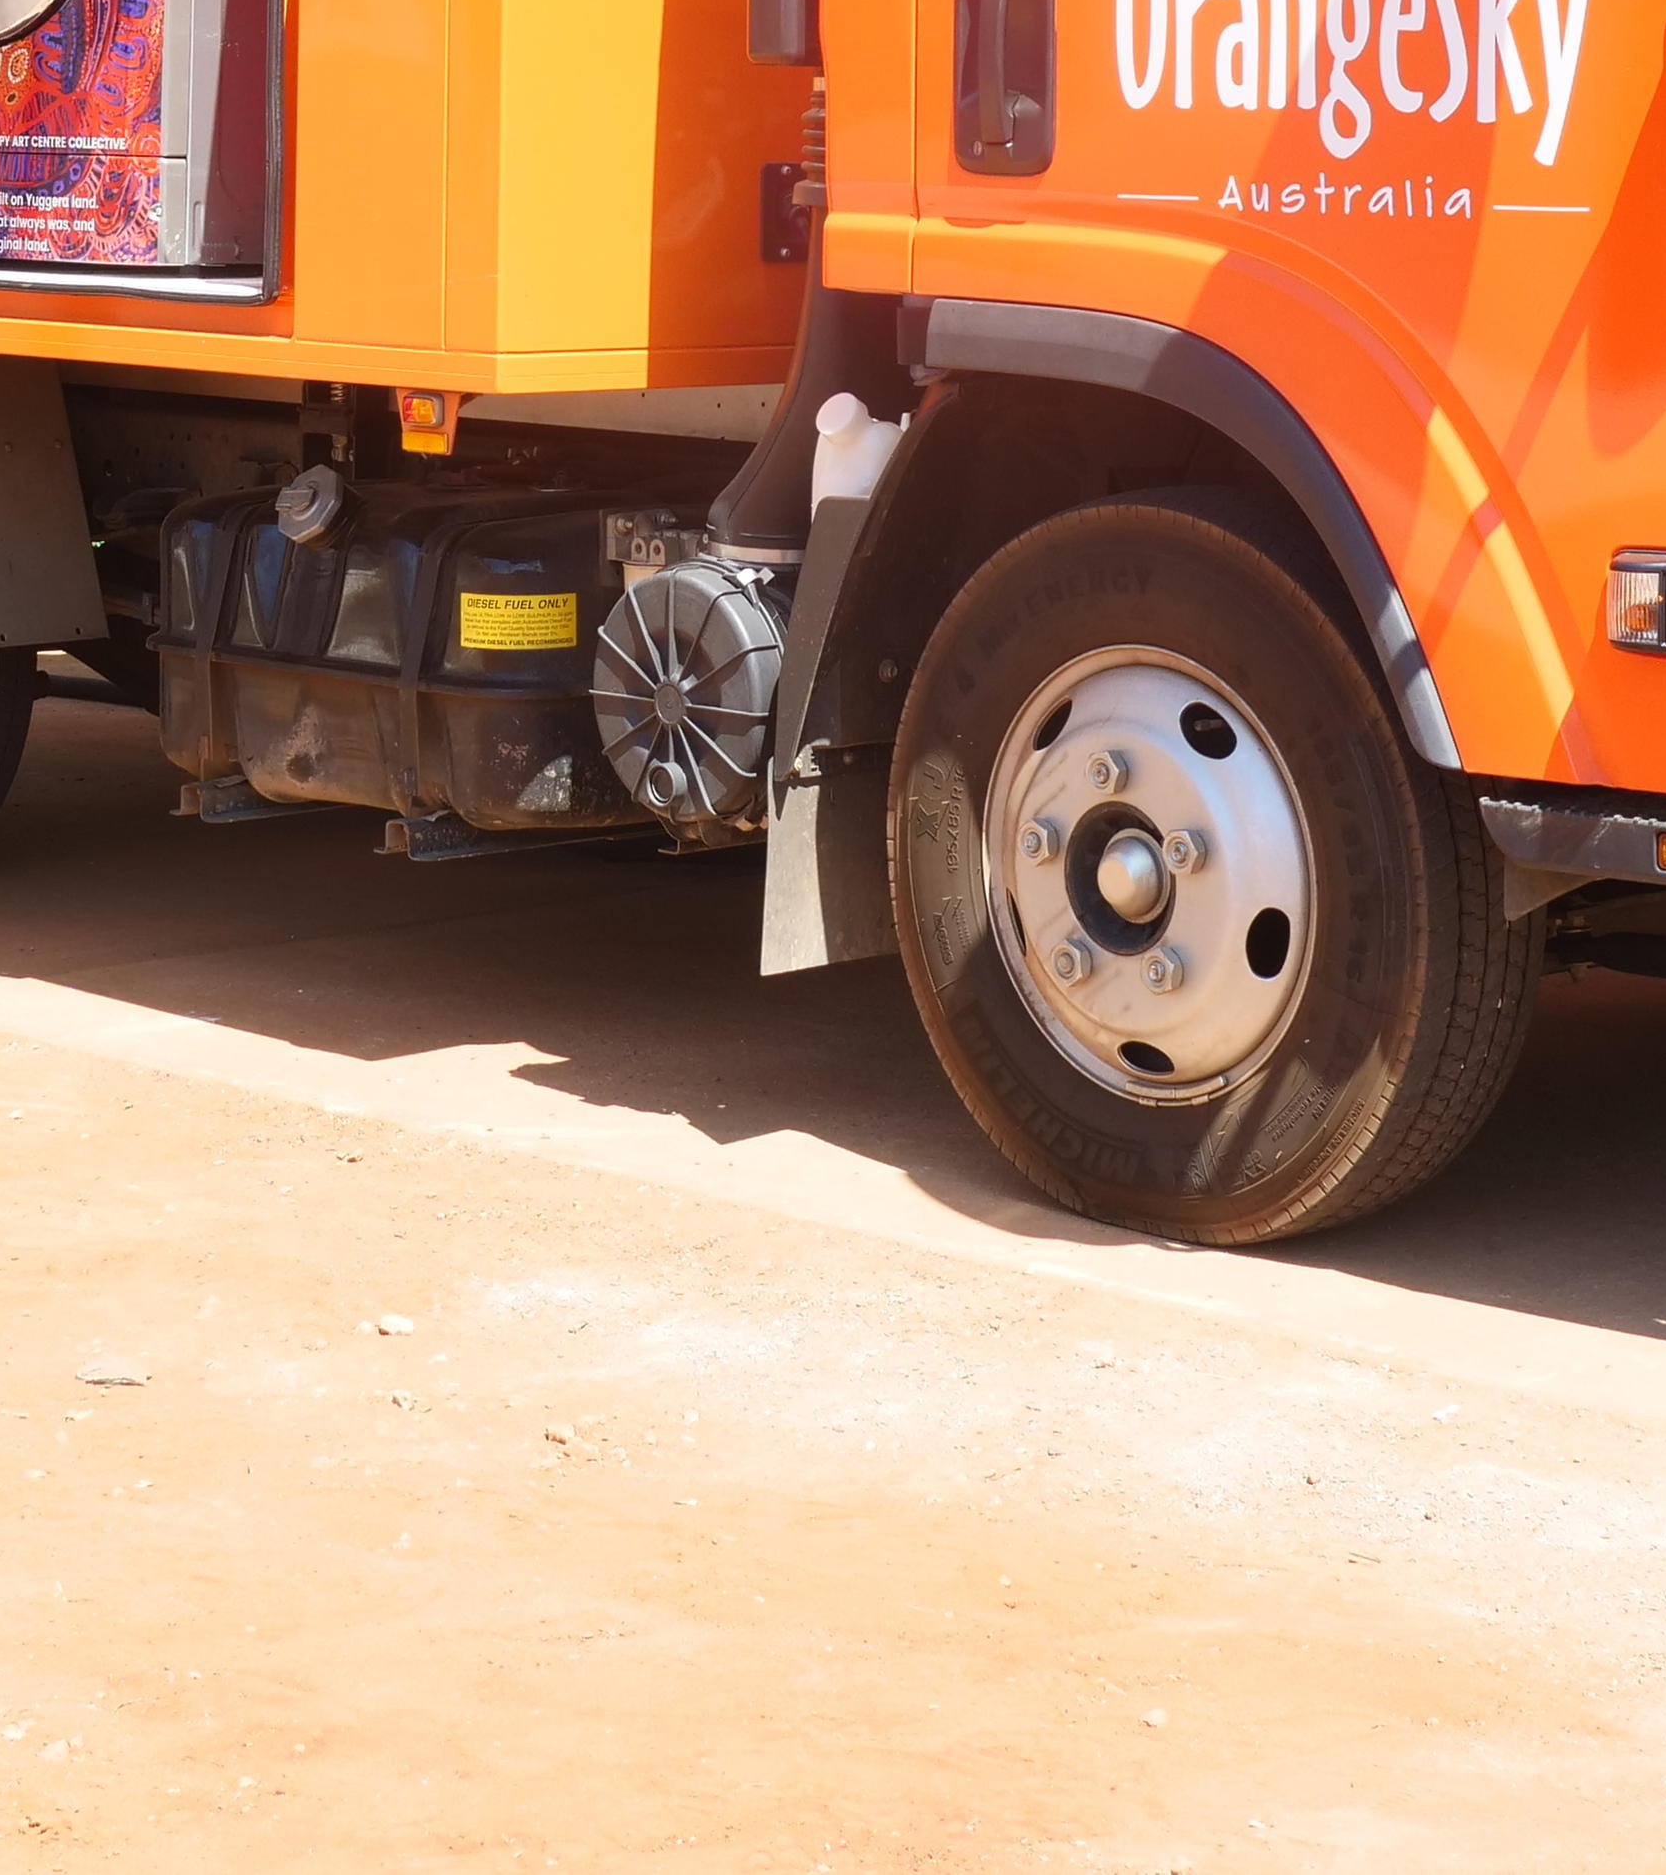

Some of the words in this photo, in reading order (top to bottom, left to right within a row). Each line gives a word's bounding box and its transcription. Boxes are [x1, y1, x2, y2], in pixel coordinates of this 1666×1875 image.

[12, 135, 29, 147] ART
[31, 136, 66, 148] CENTRE
[68, 137, 126, 150] COLLECTIVE
[11, 195, 24, 206] on
[25, 193, 70, 211] Yuggera
[72, 194, 99, 209] land.
[1218, 173, 1472, 219] Australia
[9, 214, 45, 232] always
[47, 221, 71, 232] was,
[73, 218, 95, 232] and
[25, 236, 50, 252] land.
[467, 598, 501, 609] DIESEL
[504, 599, 534, 610] FUEL
[538, 597, 569, 609] ONLY
